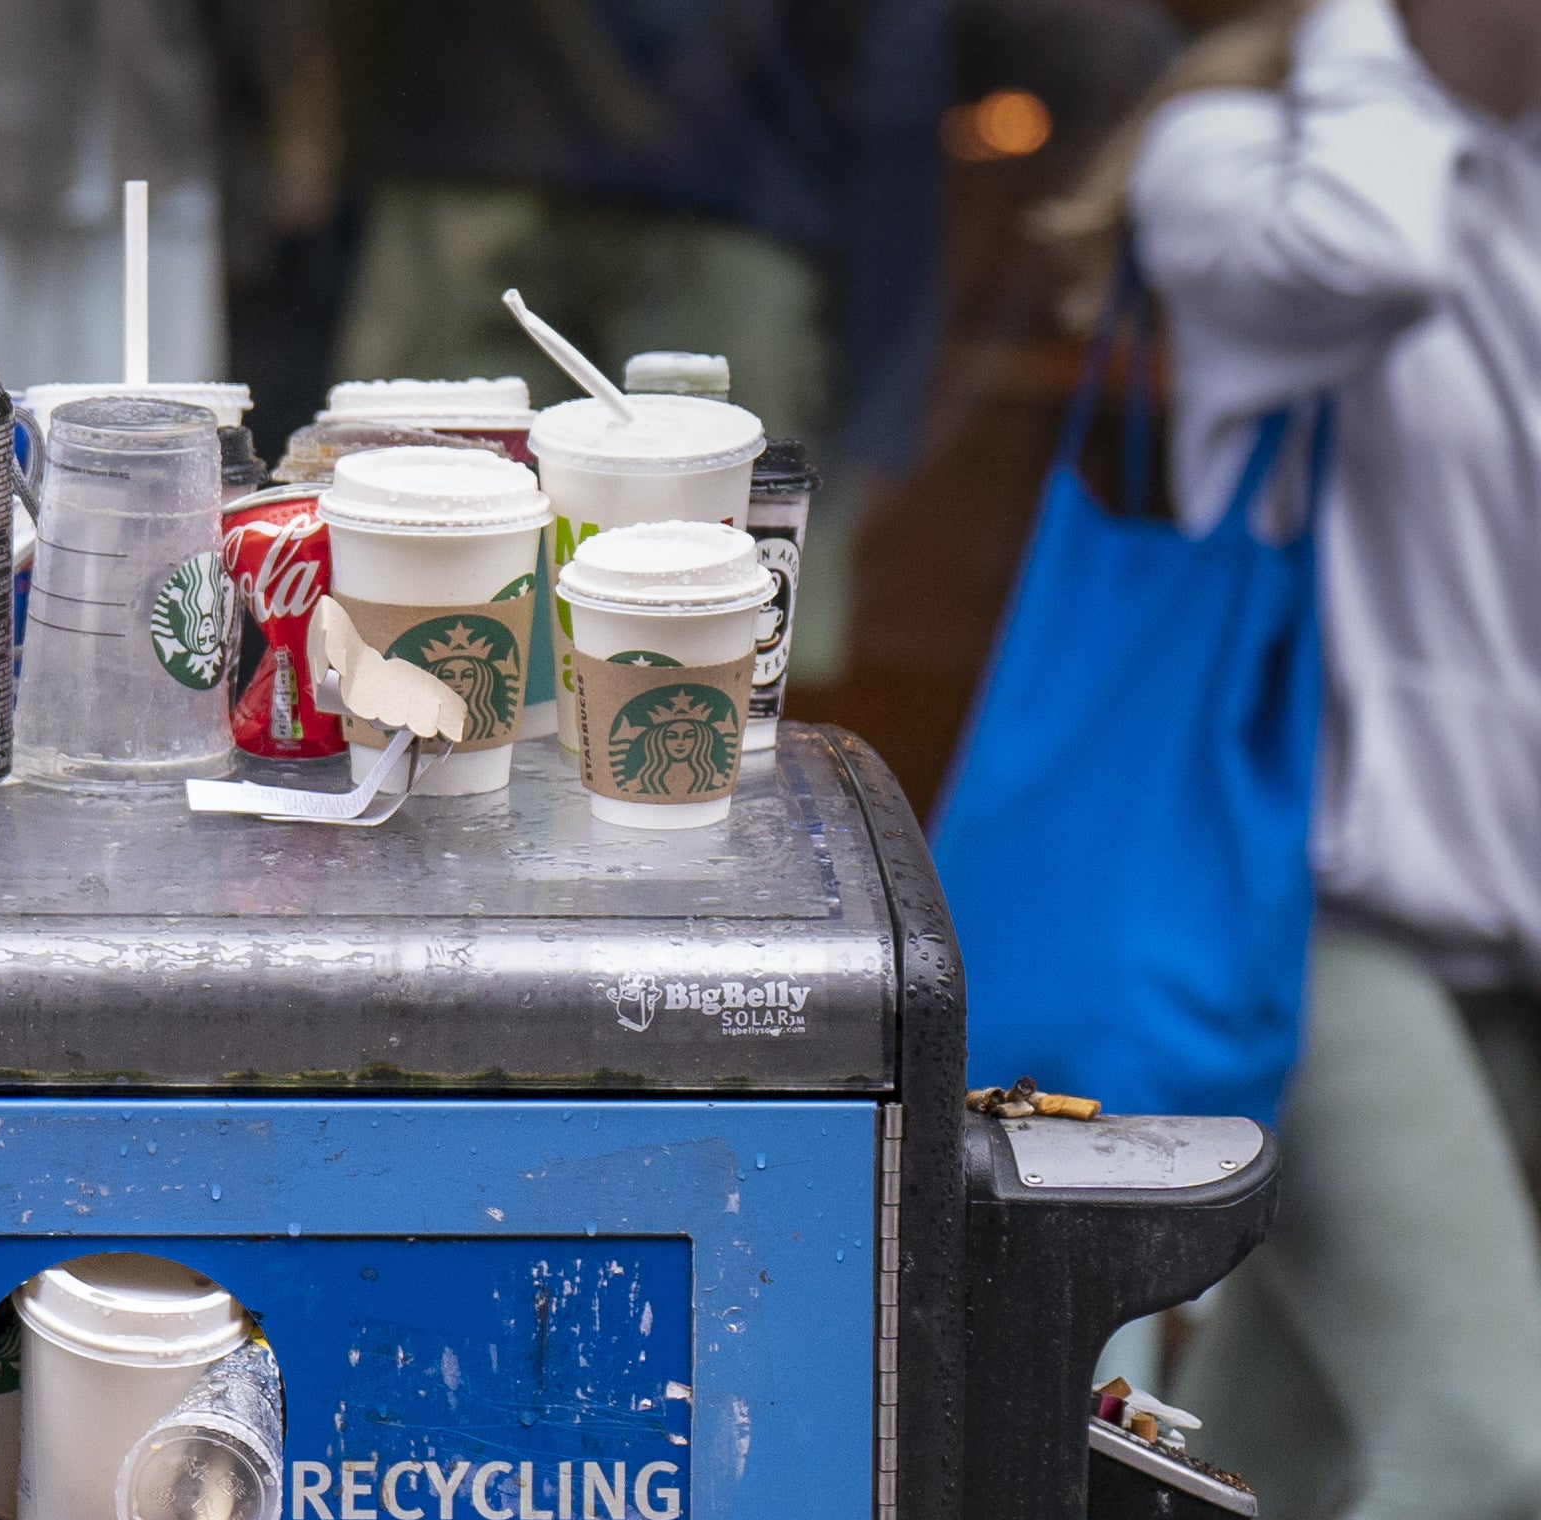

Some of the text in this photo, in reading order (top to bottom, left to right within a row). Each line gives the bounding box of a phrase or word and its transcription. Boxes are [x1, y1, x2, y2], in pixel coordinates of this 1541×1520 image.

[577, 672, 594, 782] STARBUCKS
[665, 981, 811, 1016] BigBelly
[721, 1010, 790, 1026] SOLAR
